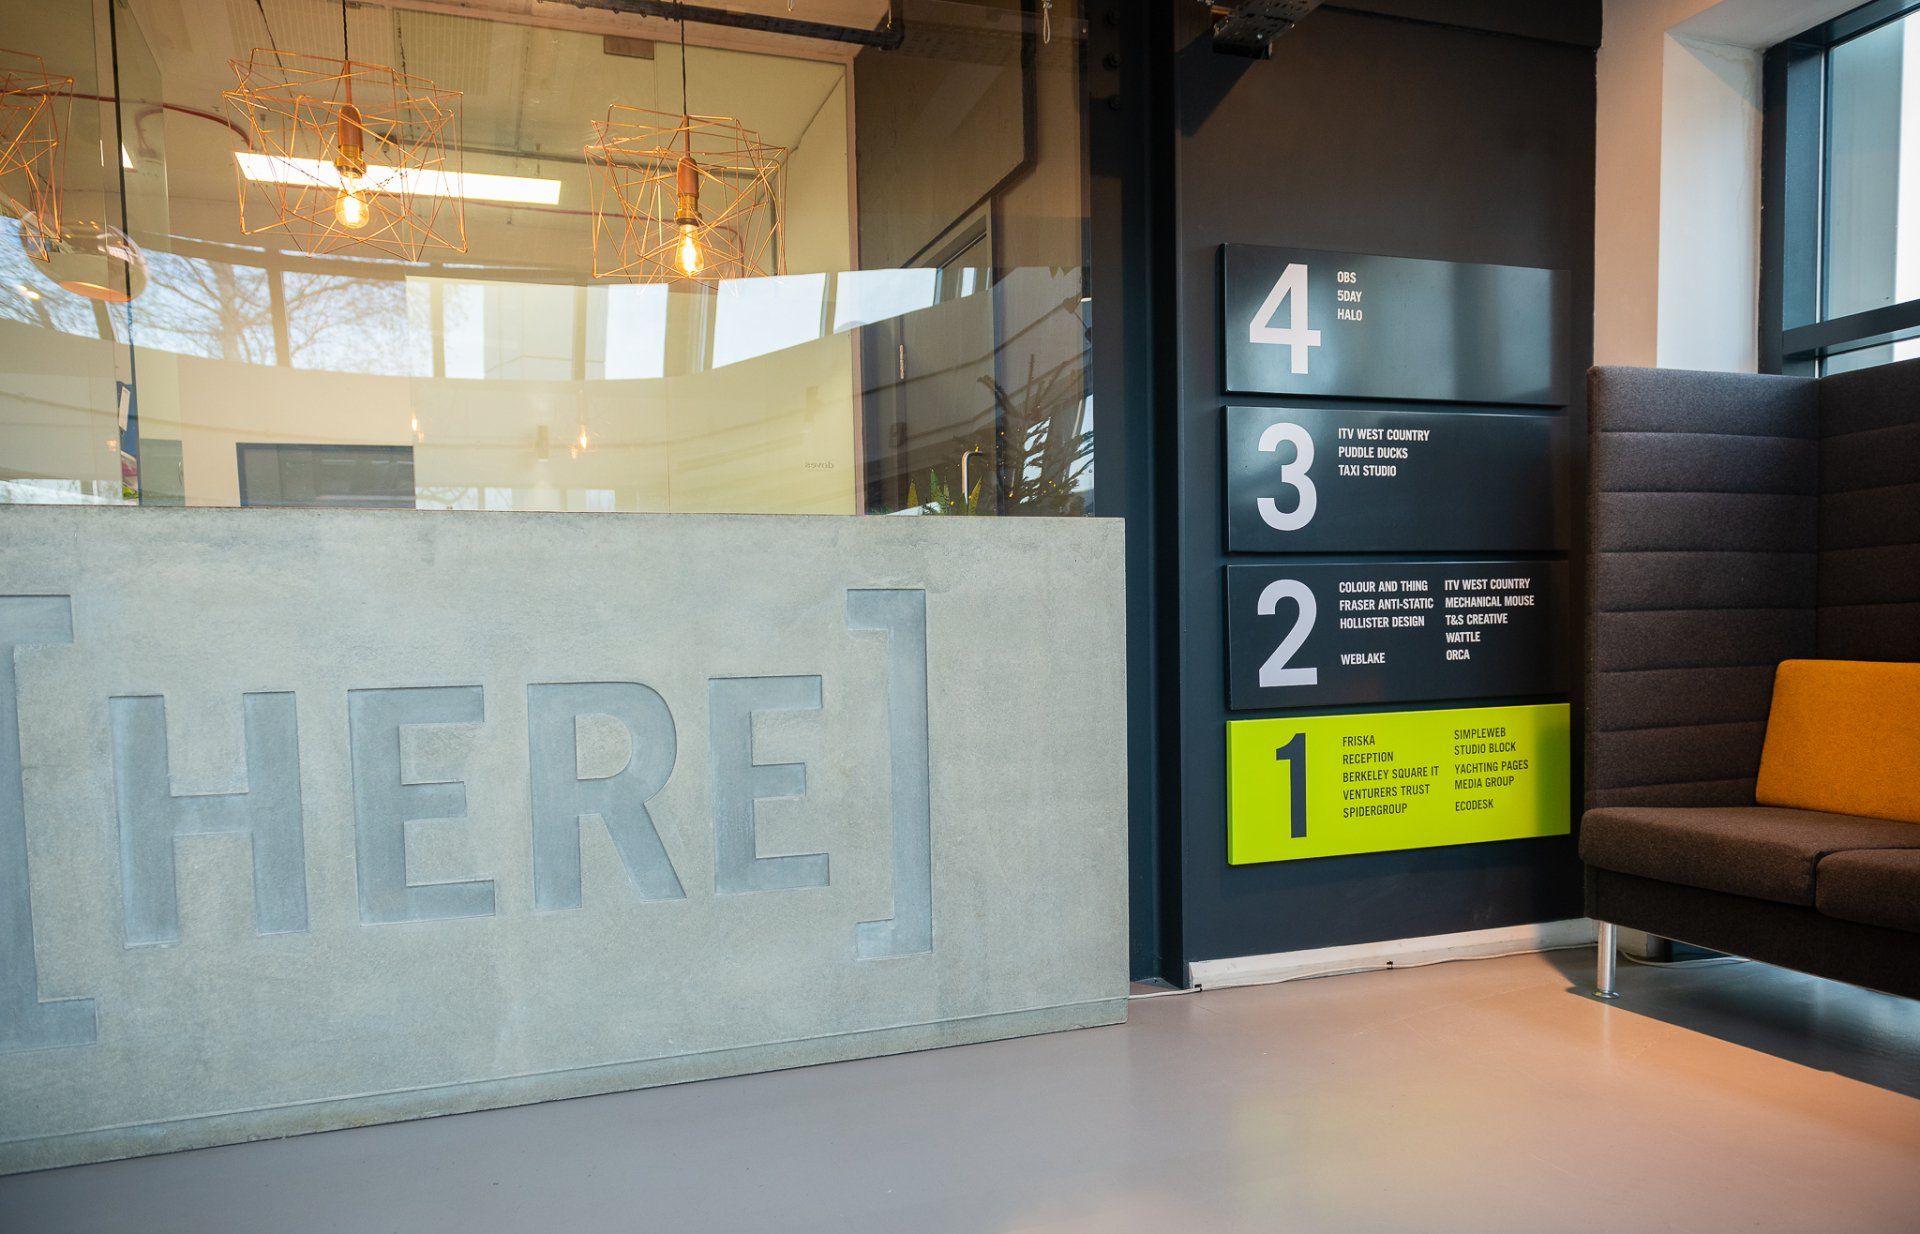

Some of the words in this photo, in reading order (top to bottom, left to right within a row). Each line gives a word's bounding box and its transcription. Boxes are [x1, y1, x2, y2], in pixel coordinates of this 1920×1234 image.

[1337, 271, 1356, 283] OBS
[1337, 290, 1362, 302] 5DAY
[1250, 263, 1321, 374] 4
[1338, 308, 1362, 321] HALO
[1339, 428, 1354, 439] ITV
[1357, 428, 1384, 440] WEST
[1387, 429, 1430, 441] COUNTRY
[1339, 446, 1374, 458] PUDDLE
[1377, 447, 1408, 458] DUCKS
[1257, 422, 1317, 531] 3
[1338, 465, 1359, 476] TAXI
[1363, 465, 1396, 476] STUDIO
[1339, 581, 1375, 593] COLOUR
[1378, 581, 1398, 592] AND
[1400, 580, 1428, 591] THING
[1445, 580, 1459, 590] ITV
[1462, 579, 1488, 590] WEST
[1491, 578, 1530, 589] COUNTRY
[1340, 600, 1375, 611] FRASER
[1378, 598, 1434, 610] ANTI-STATIC
[1445, 597, 1502, 608] MECHANICAL
[1505, 596, 1534, 606] MOUSE
[1340, 617, 1389, 628] HOLLISTER
[1392, 616, 1425, 627] DESIGN
[1445, 614, 1464, 625] T&S
[1467, 613, 1508, 625] CREATIVE
[1258, 579, 1317, 687] 2
[1446, 632, 1480, 643] WATTLE
[1341, 652, 1385, 665] WEBLAKE
[1446, 650, 1470, 660] ORCA
[1454, 728, 1506, 739] SIMPLEWEB
[1343, 735, 1375, 746] FRISKA
[1454, 744, 1486, 755] STUDIO
[1489, 742, 1516, 753] BLOCK
[1343, 752, 1393, 764] RECEPTION
[1455, 762, 1498, 774] YACHTING
[1502, 760, 1529, 771] PAGES
[1343, 769, 1388, 782] BERKELEY
[1392, 767, 1428, 779] SQUARE
[1431, 766, 1439, 776] IT
[1276, 733, 1307, 838] 1
[1455, 778, 1482, 790] MEDIA
[1486, 776, 1514, 787] GROUP
[1343, 787, 1398, 800] VENTURERS
[1401, 784, 1430, 795] TRUST
[1343, 803, 1407, 818] SPIDERGROUP
[1456, 799, 1494, 811] ECODESK
